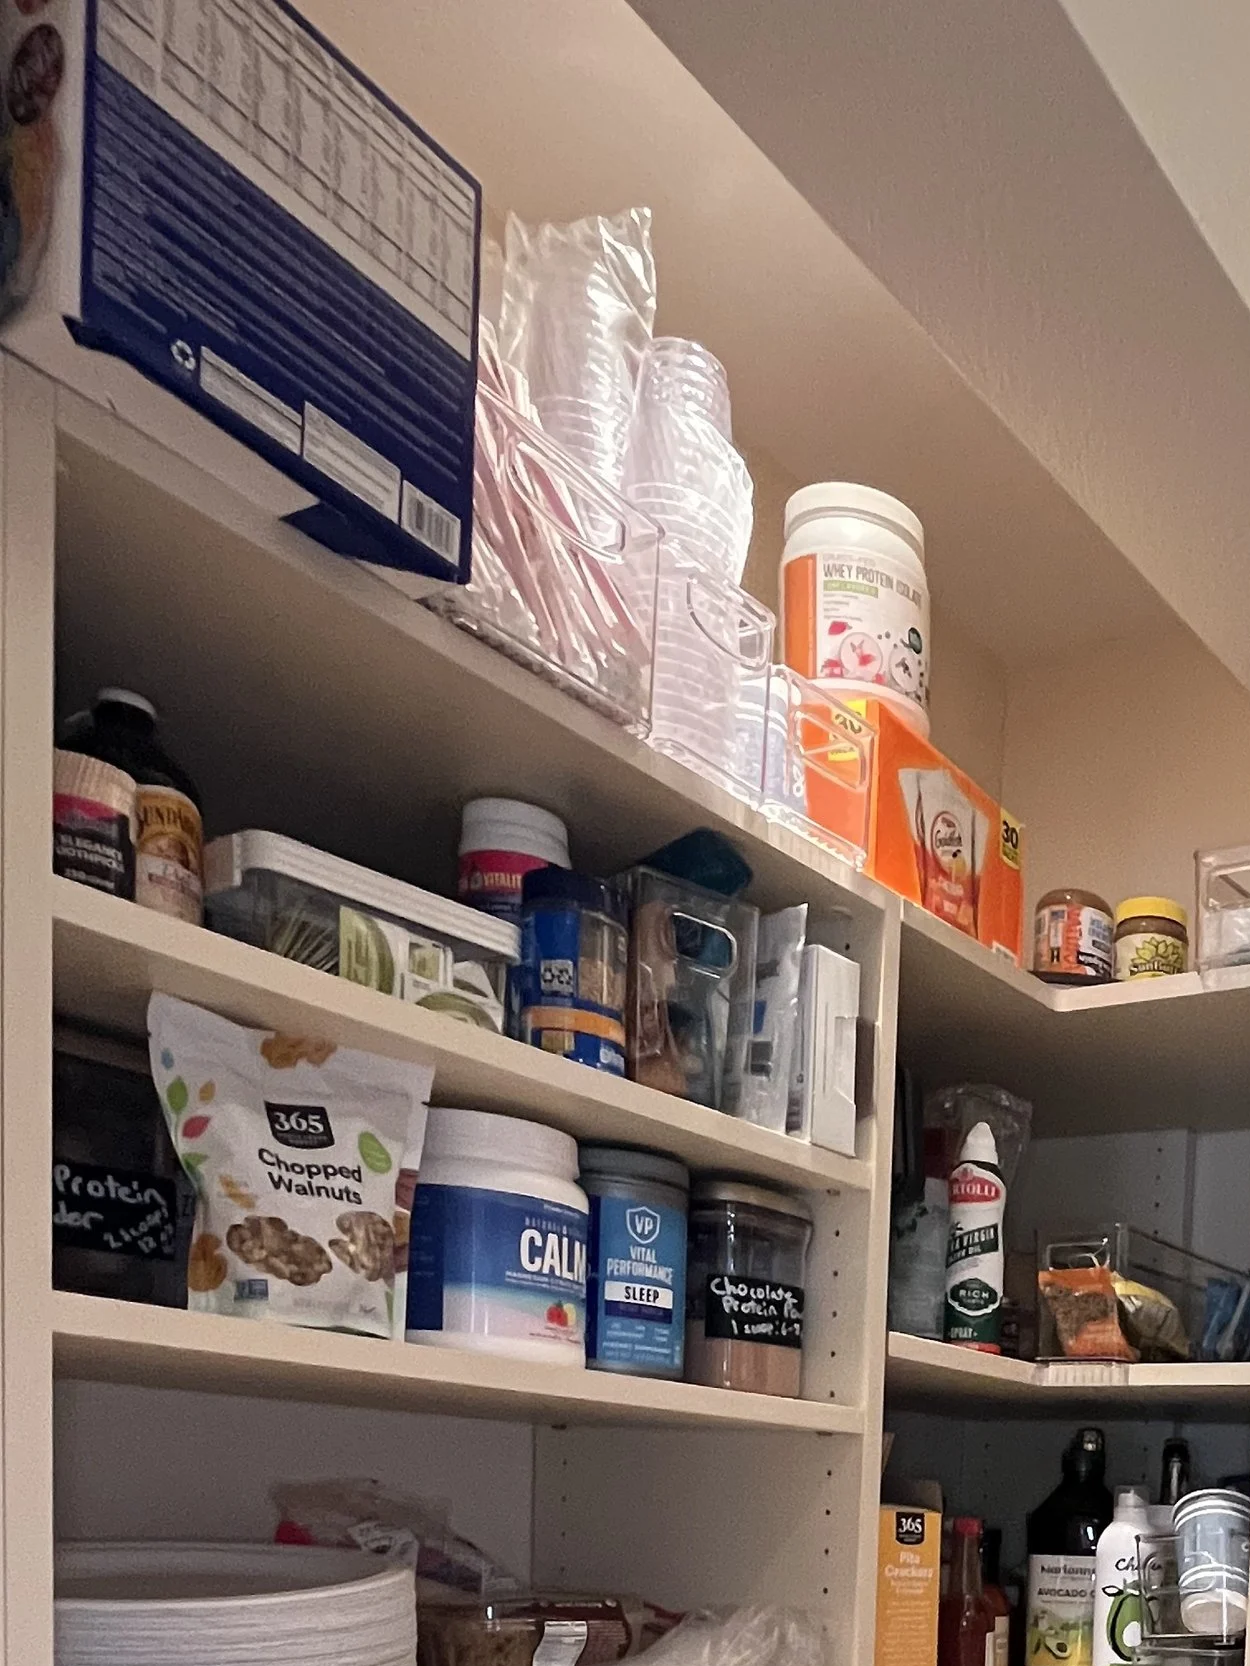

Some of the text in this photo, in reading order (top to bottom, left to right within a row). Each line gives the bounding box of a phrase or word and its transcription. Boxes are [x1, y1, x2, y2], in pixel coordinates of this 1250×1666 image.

[1003, 820, 1019, 850] 30
[274, 1111, 324, 1135] 365
[257, 1148, 362, 1183] Chopped
[53, 1163, 169, 1218] Protein
[267, 1171, 363, 1206] Walnuts
[952, 1183, 996, 1197] RTOLLI
[53, 1200, 105, 1230] der
[634, 1214, 654, 1236] VP
[962, 1226, 996, 1248] VIRGIN
[629, 1246, 657, 1264] VITAL
[606, 1258, 674, 1286] PERFORMANCE
[623, 1285, 660, 1304] SLEEP
[958, 1288, 990, 1299] RICH
[899, 1517, 922, 1534] 365
[1037, 1587, 1088, 1598] AVOCADO
